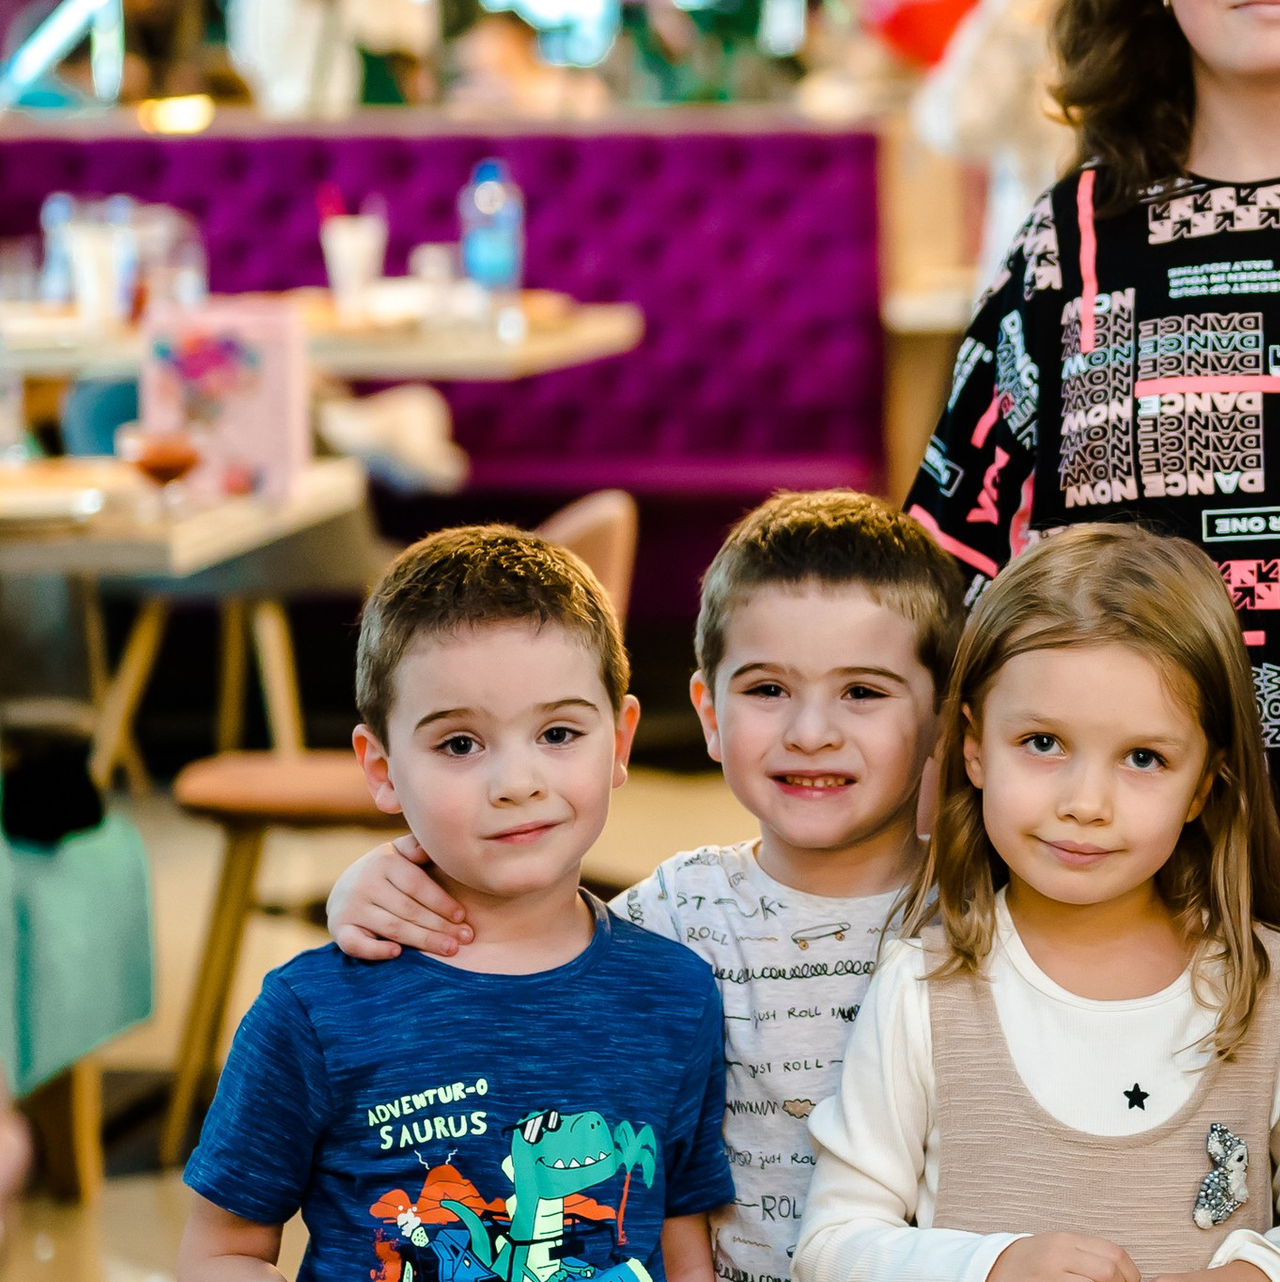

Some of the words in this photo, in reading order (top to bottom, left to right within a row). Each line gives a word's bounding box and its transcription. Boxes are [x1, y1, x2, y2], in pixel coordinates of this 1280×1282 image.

[1138, 312, 1264, 338] DANCE
[1138, 332, 1264, 358] DANCE
[1138, 352, 1264, 376] DANCE
[1138, 391, 1263, 416] DANCE
[1138, 412, 1263, 436] DANCE
[1138, 431, 1263, 456] DANCE
[1138, 452, 1264, 476] DANCE
[1141, 471, 1265, 497] DANCE
[1215, 516, 1267, 535] ONE
[686, 926, 729, 946] ROLL
[783, 1059, 823, 1073] ROLL
[367, 1078, 488, 1127] ADVENTUR-O
[380, 1111, 487, 1150] SAURUS
